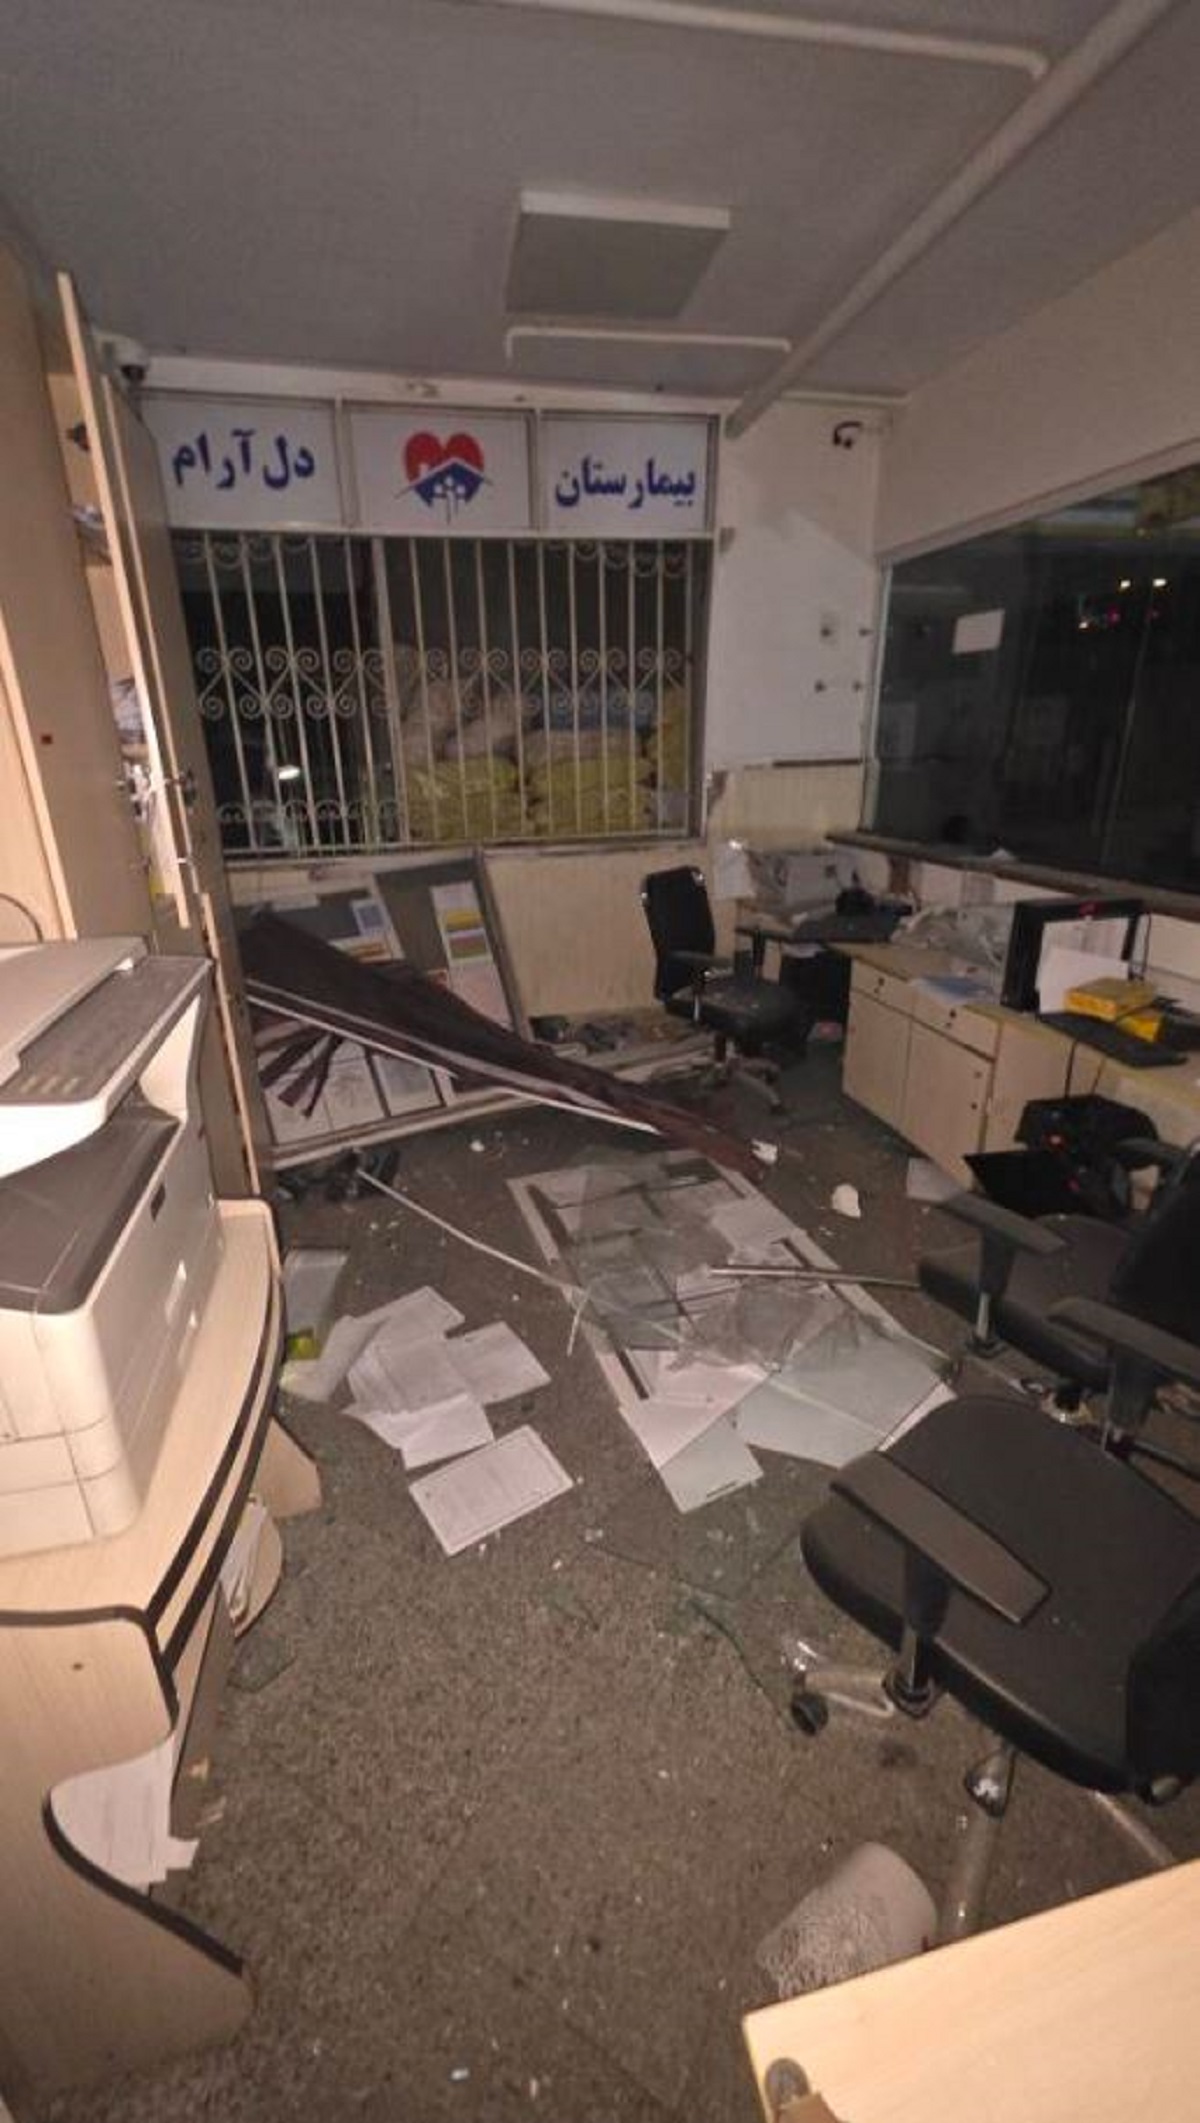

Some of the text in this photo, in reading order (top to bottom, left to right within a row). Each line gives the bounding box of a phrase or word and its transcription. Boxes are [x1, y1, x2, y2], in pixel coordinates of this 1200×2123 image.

[172, 428, 316, 490] دل آرام
[555, 455, 696, 509] بیمارستان
